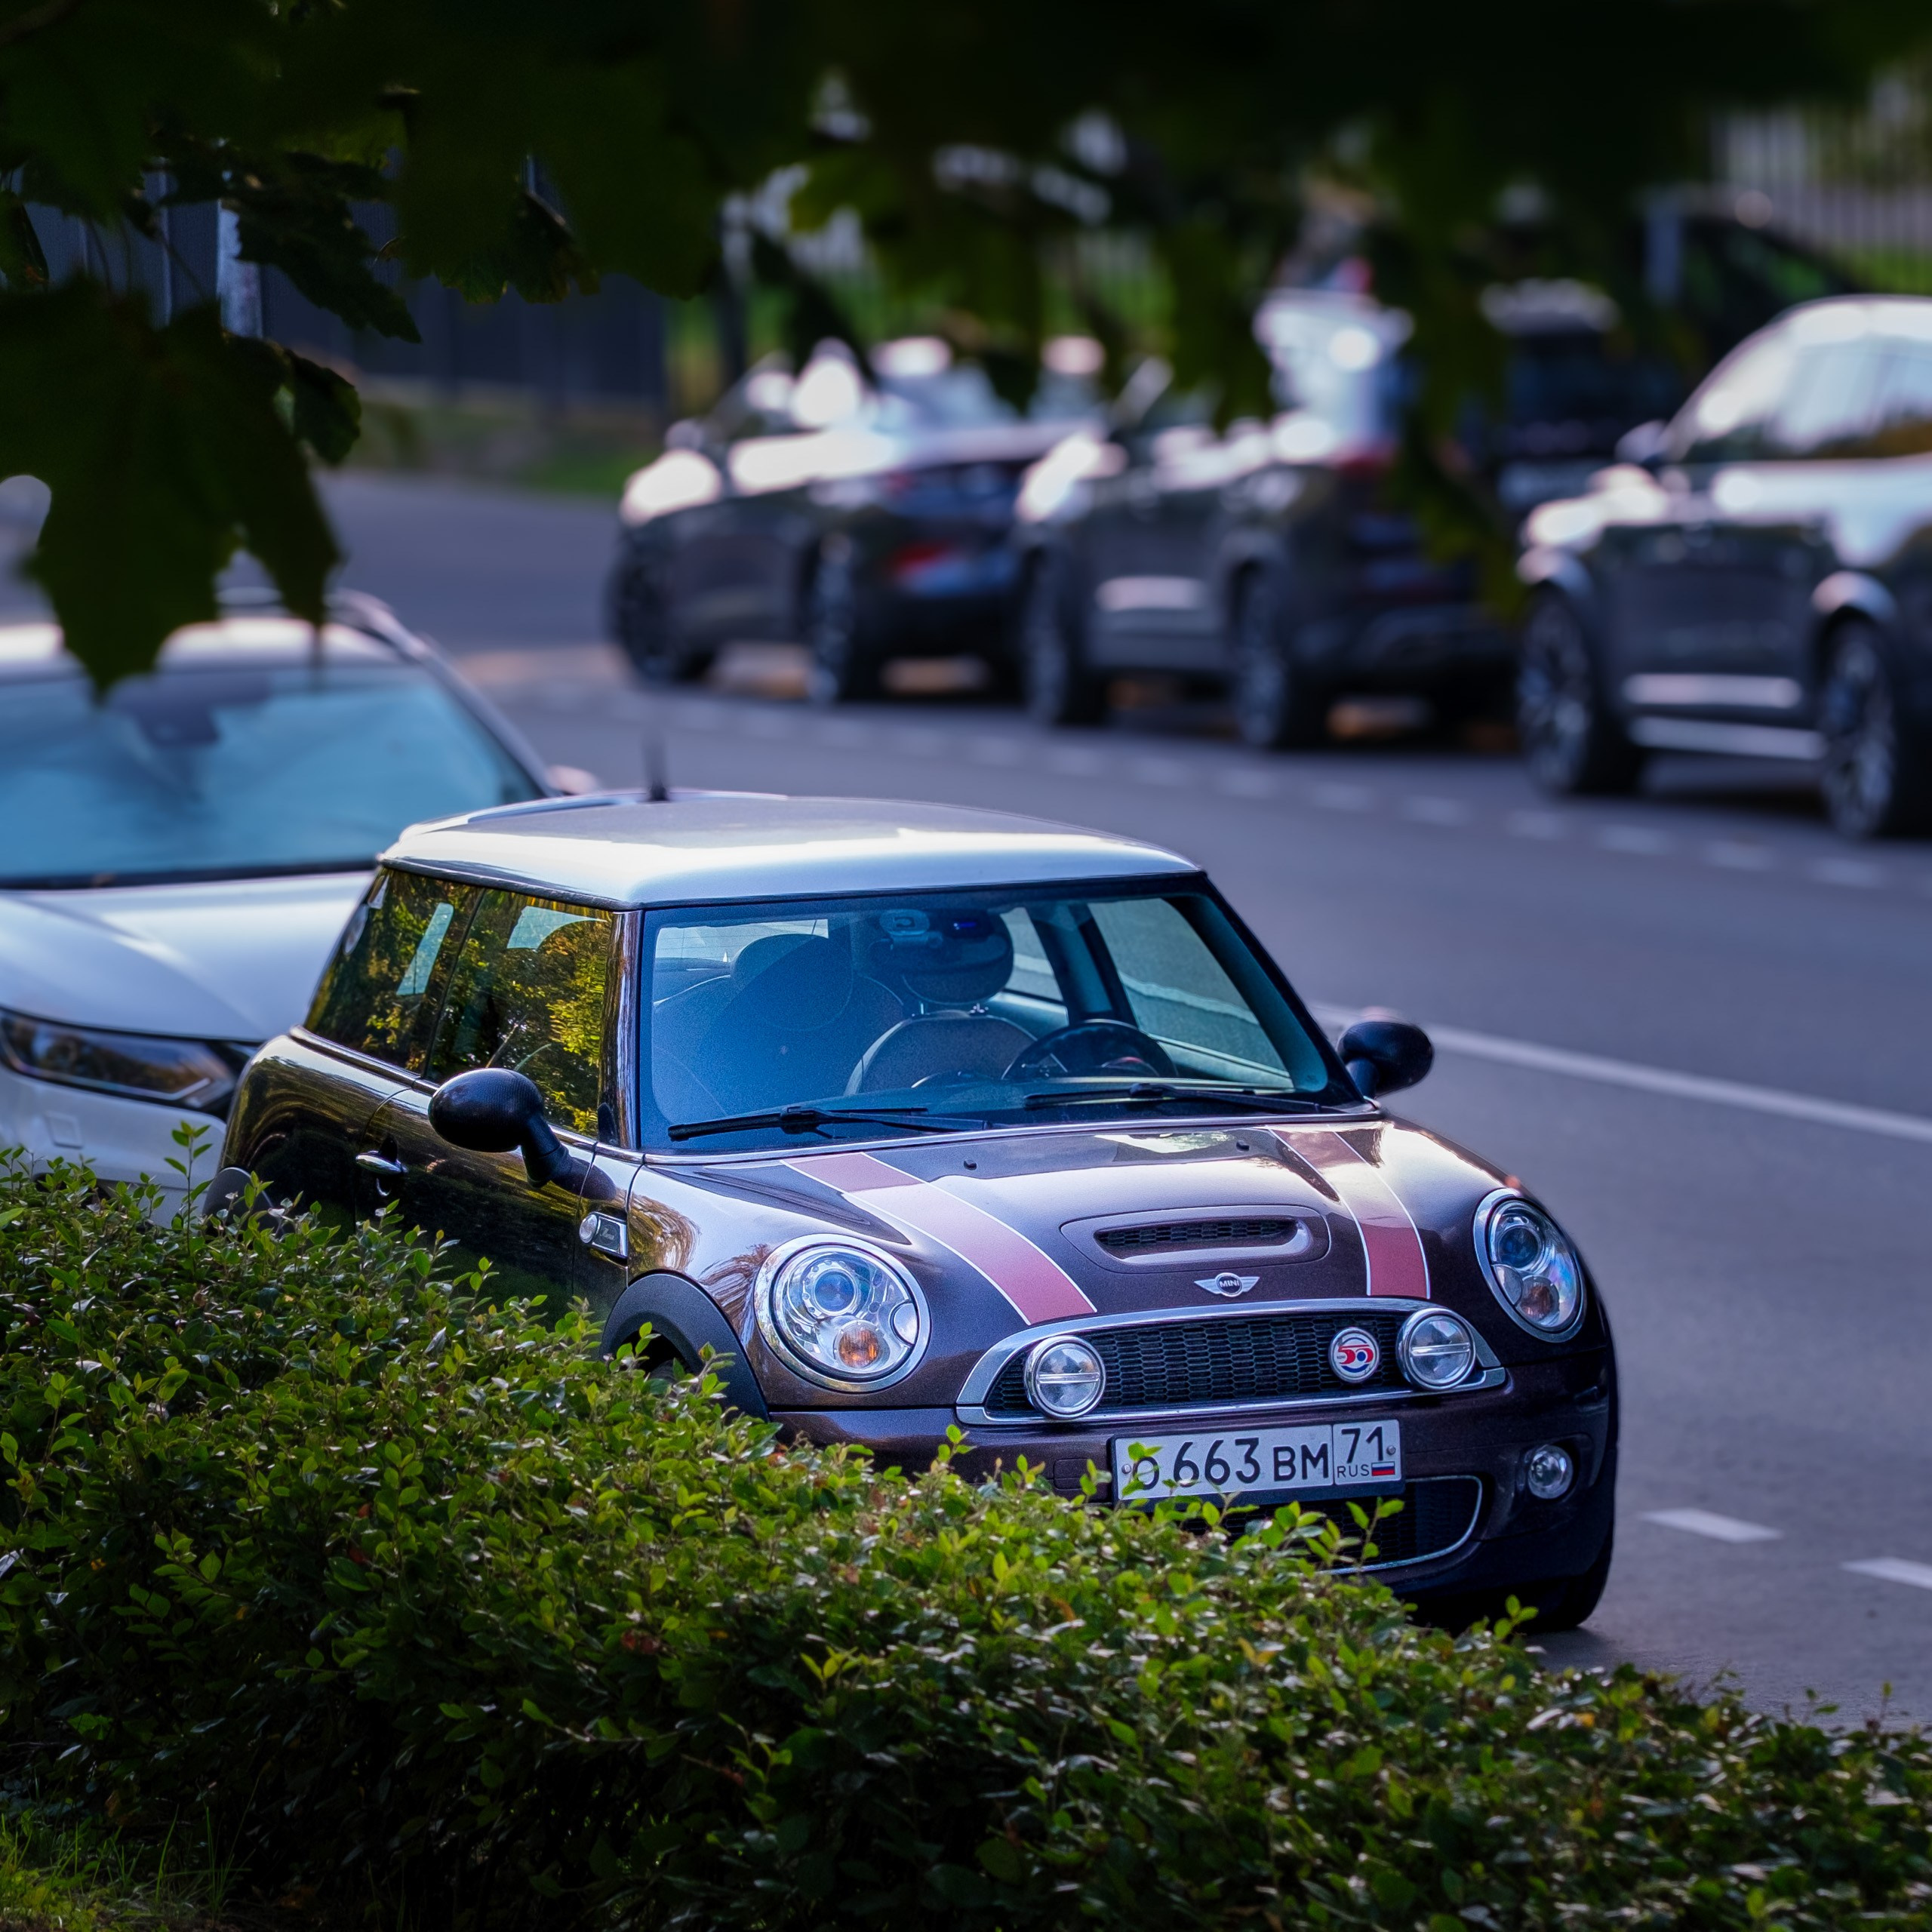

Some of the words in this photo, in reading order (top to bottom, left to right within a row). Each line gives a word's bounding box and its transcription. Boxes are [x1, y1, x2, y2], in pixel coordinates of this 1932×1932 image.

[1219, 1279, 1240, 1287] MINI
[1341, 1426, 1383, 1463] 71
[1337, 1464, 1370, 1478] RUS
